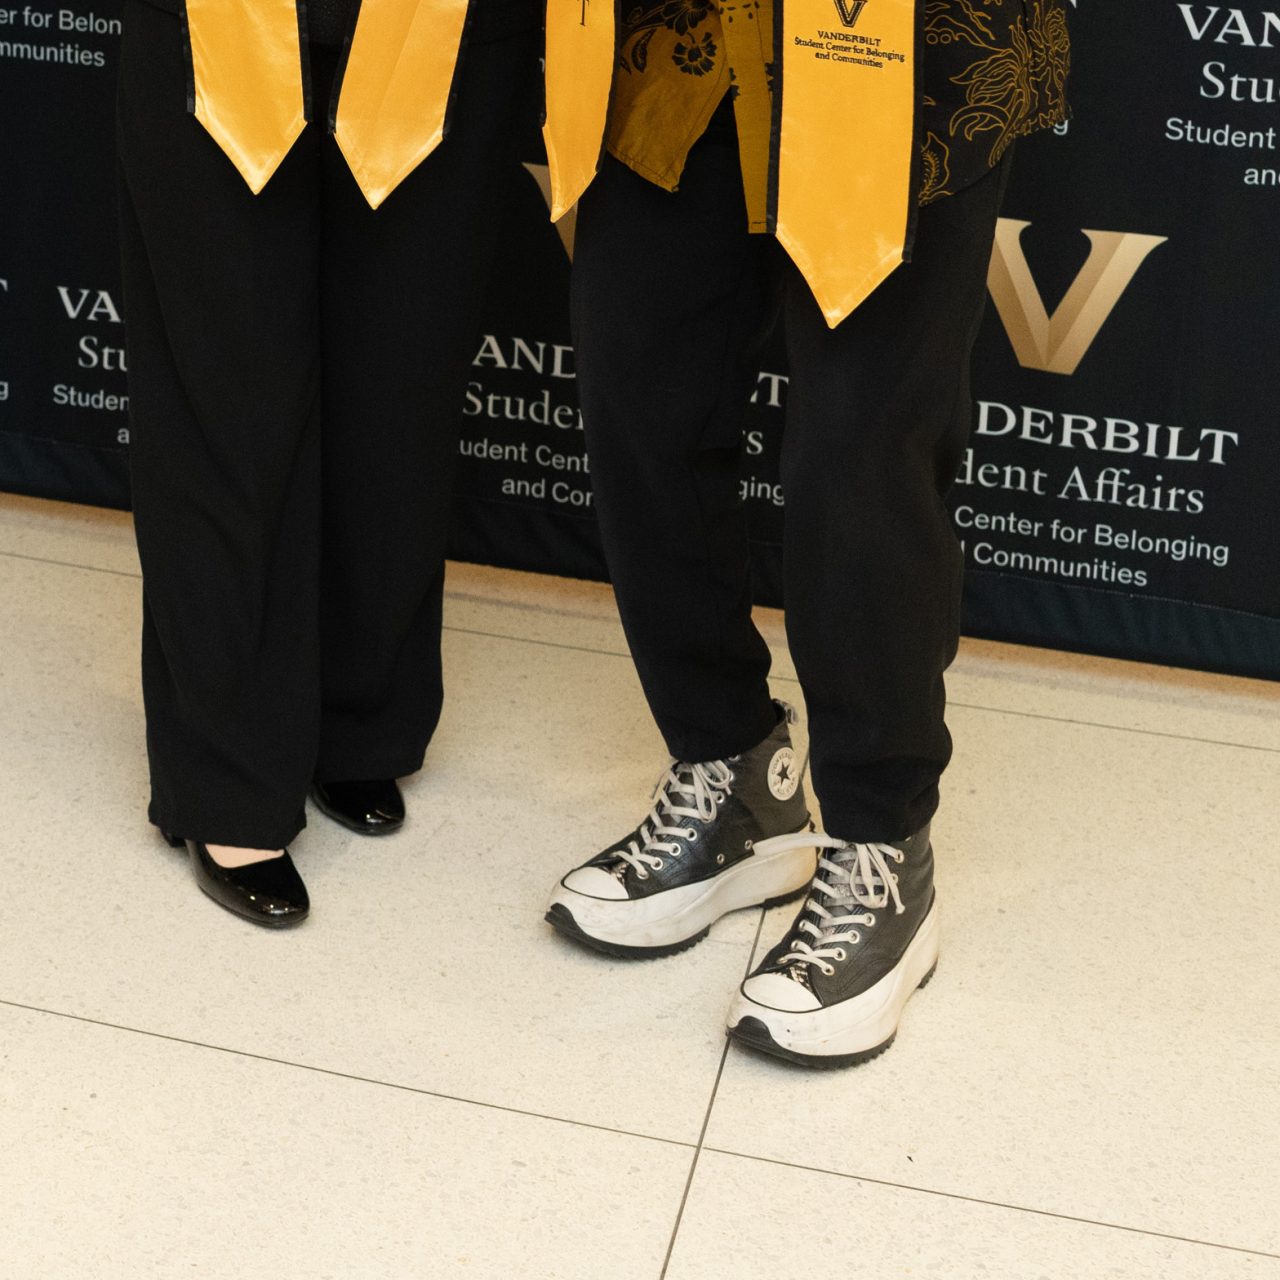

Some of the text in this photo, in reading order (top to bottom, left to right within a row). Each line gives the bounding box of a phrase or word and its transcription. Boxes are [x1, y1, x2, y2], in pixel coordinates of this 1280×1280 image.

[22, 6, 53, 28] for
[59, 10, 122, 35] Belon
[794, 36, 905, 63] Student Center for Belonging
[817, 30, 881, 47] VANDERBILT
[815, 51, 883, 68] and Communities
[1165, 117, 1276, 149] Student
[1244, 167, 1280, 186] an
[986, 217, 1169, 375] V
[53, 384, 129, 411] Studen
[463, 381, 584, 431] Stude
[975, 400, 1239, 465] DERBILT
[460, 438, 590, 474] udent Cent
[501, 478, 545, 499] and
[955, 448, 1204, 515] dent Affairs
[955, 506, 1229, 567] Center for Belonging
[973, 542, 1148, 586] Communities
